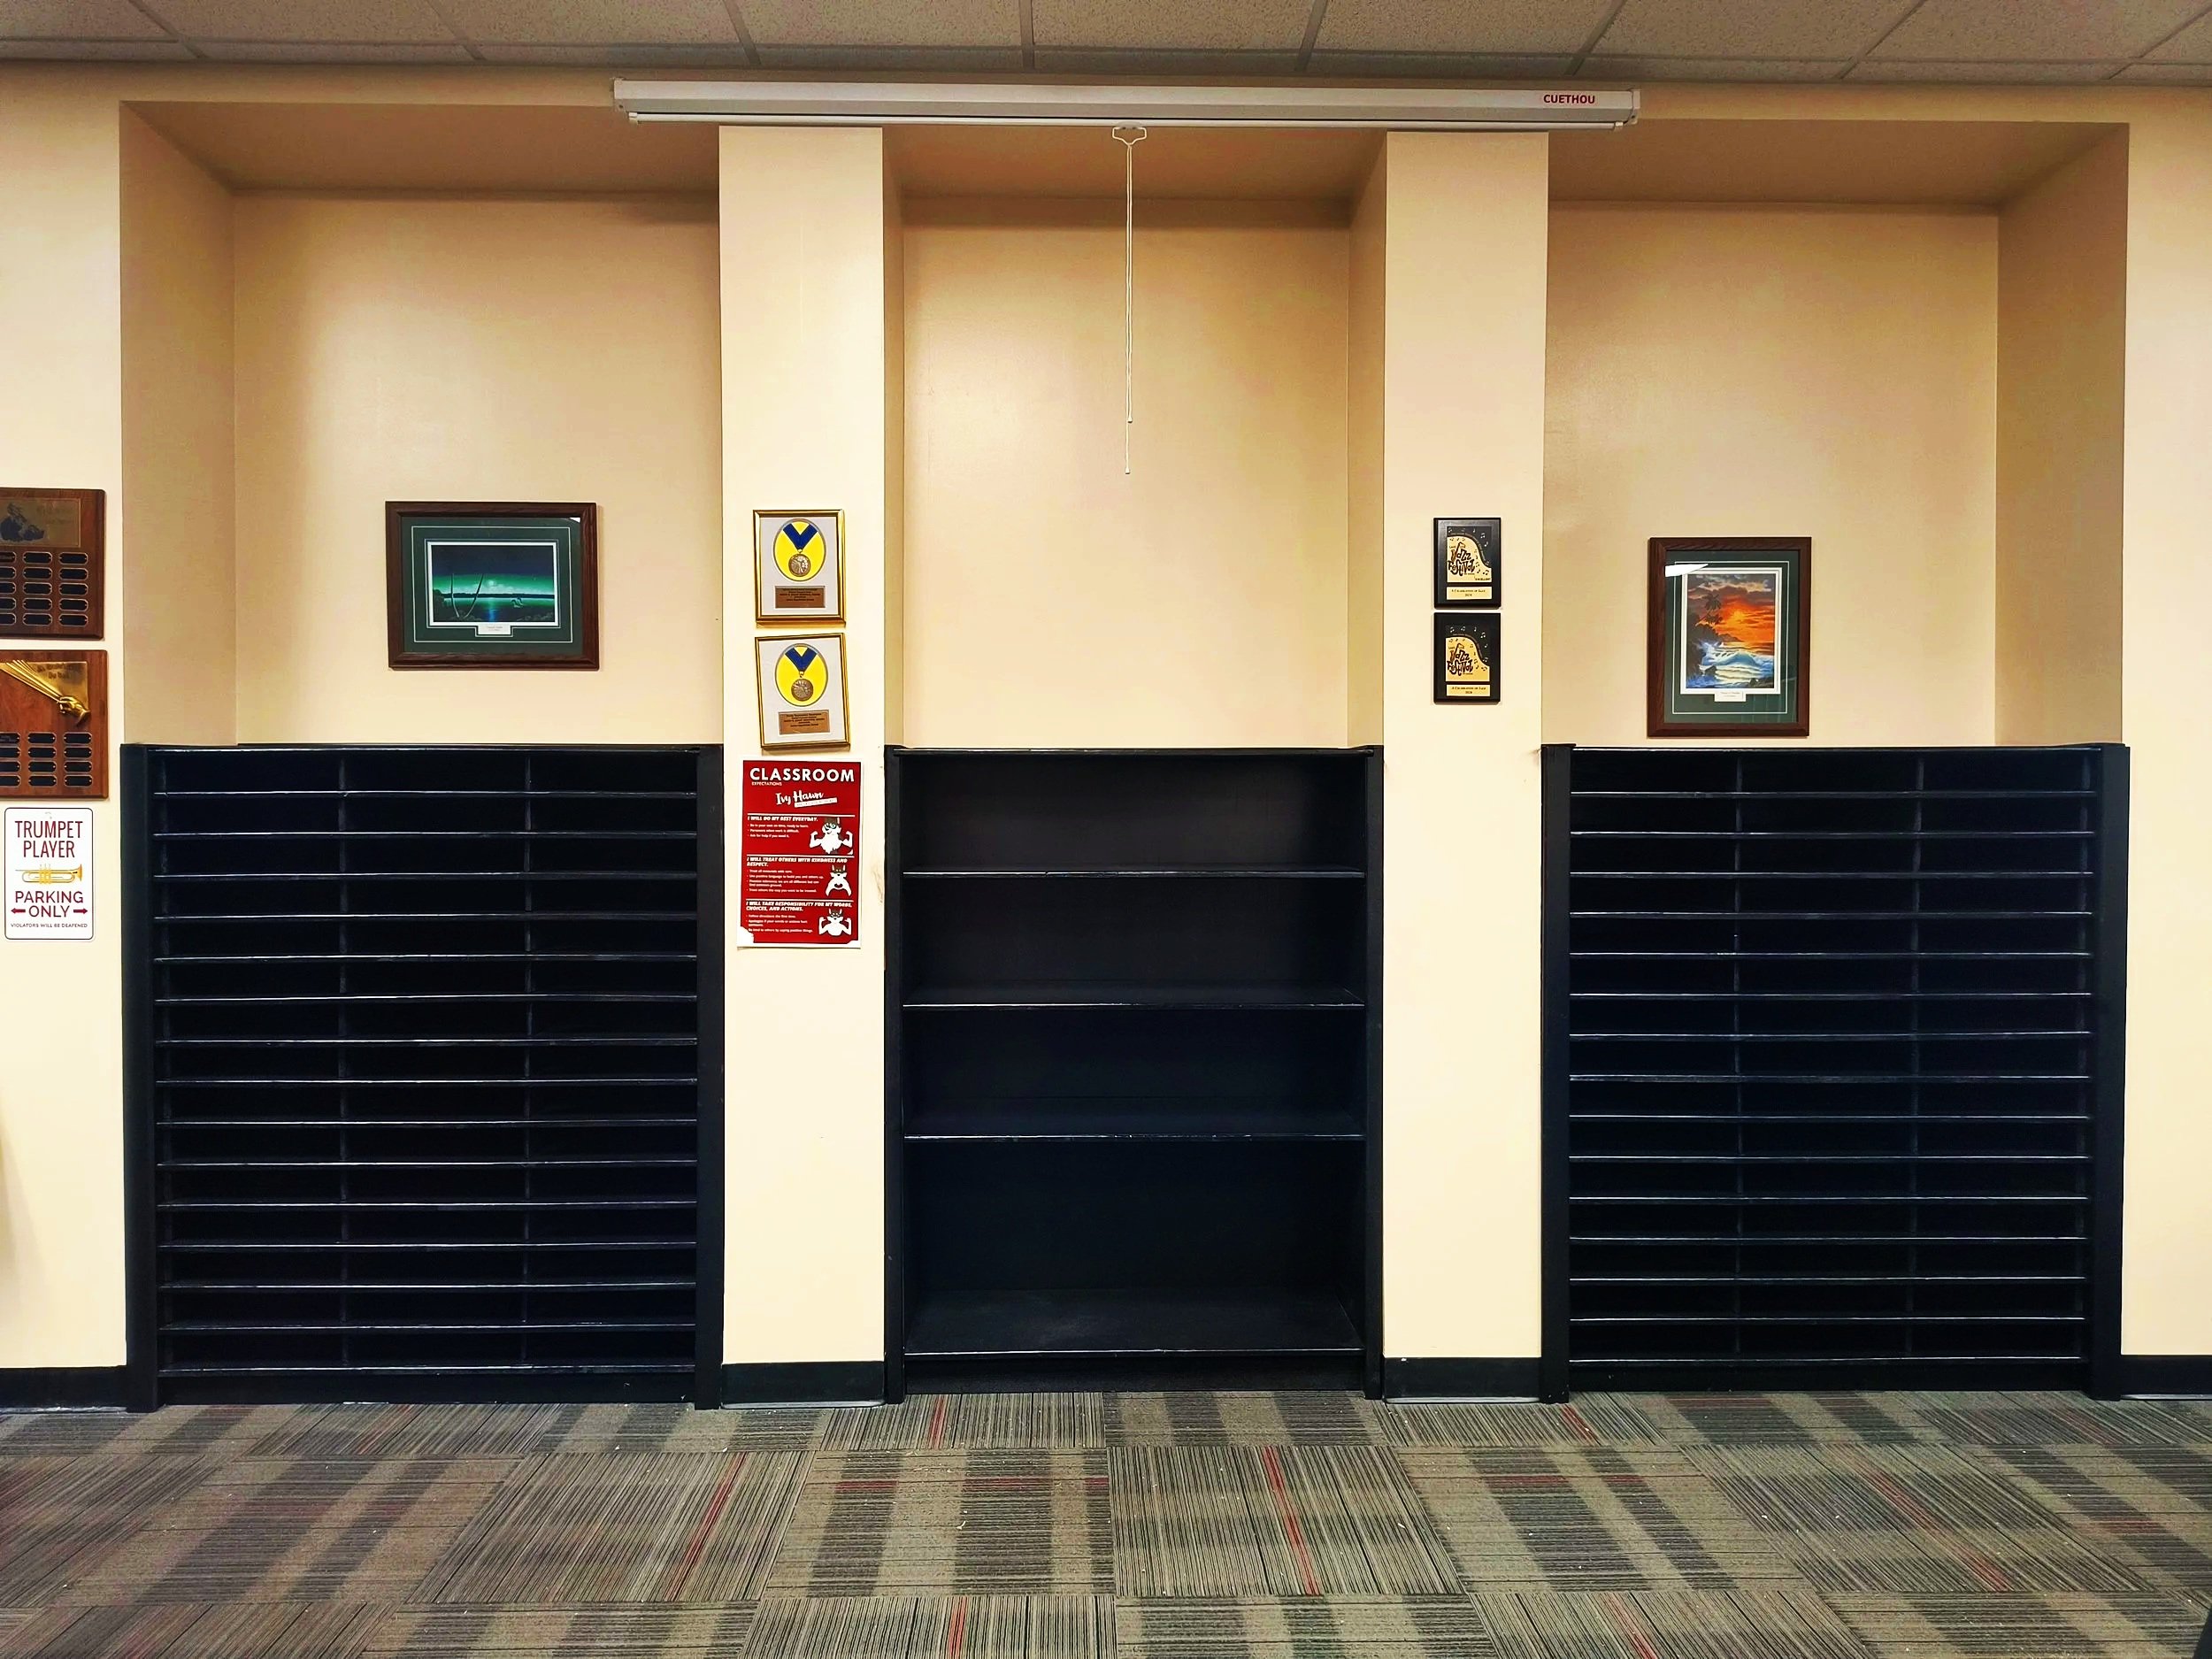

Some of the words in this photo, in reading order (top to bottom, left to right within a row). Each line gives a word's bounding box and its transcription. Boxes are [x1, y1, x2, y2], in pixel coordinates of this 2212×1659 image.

[1543, 94, 1595, 104] CUETHOU
[749, 767, 855, 782] CLASSROOM
[775, 792, 792, 805] Ivy
[15, 820, 83, 839] TRUMPET
[23, 840, 75, 858] PLAYER
[15, 890, 83, 903] PARKING
[28, 905, 70, 918] ONLY
